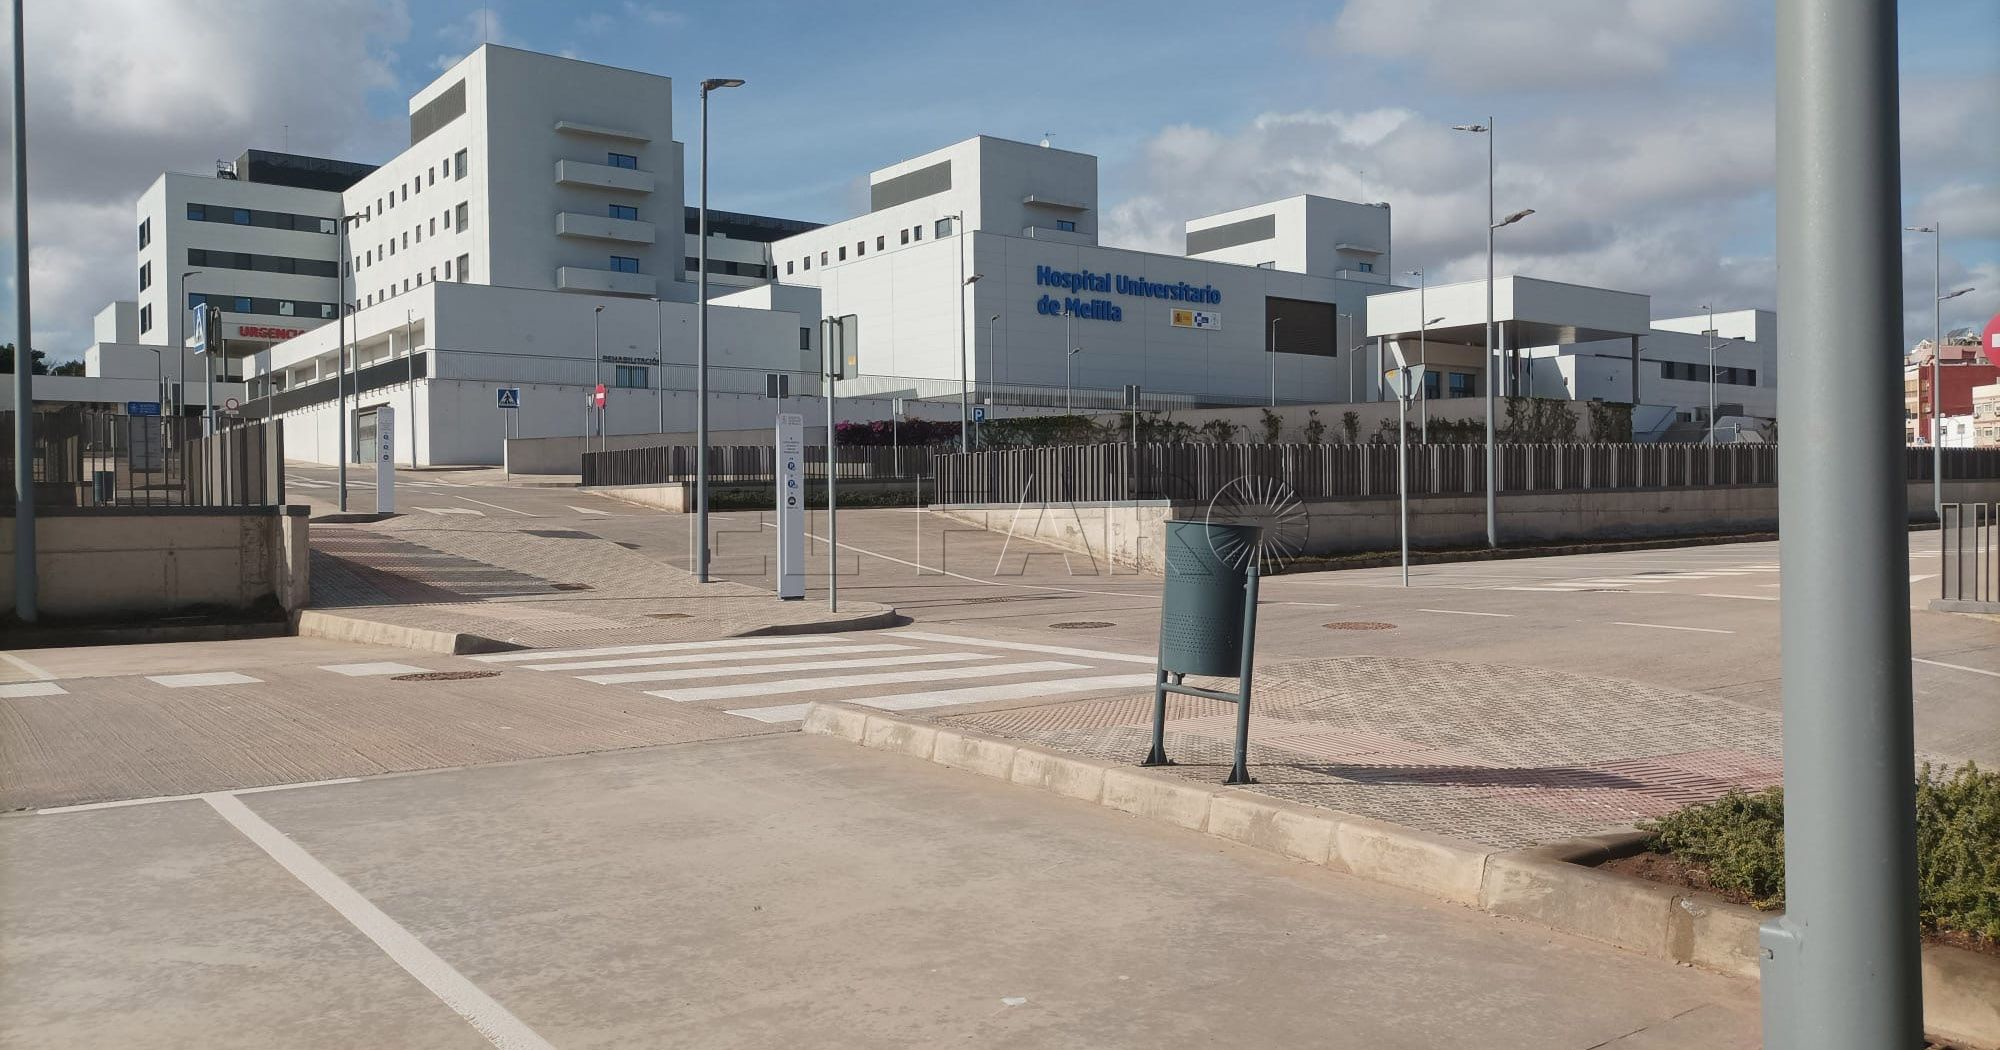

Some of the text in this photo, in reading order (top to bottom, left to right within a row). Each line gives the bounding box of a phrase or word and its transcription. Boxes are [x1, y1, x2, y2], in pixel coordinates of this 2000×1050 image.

[1037, 265, 1222, 304] Hospital Universitario
[1037, 295, 1122, 322] de Melilla
